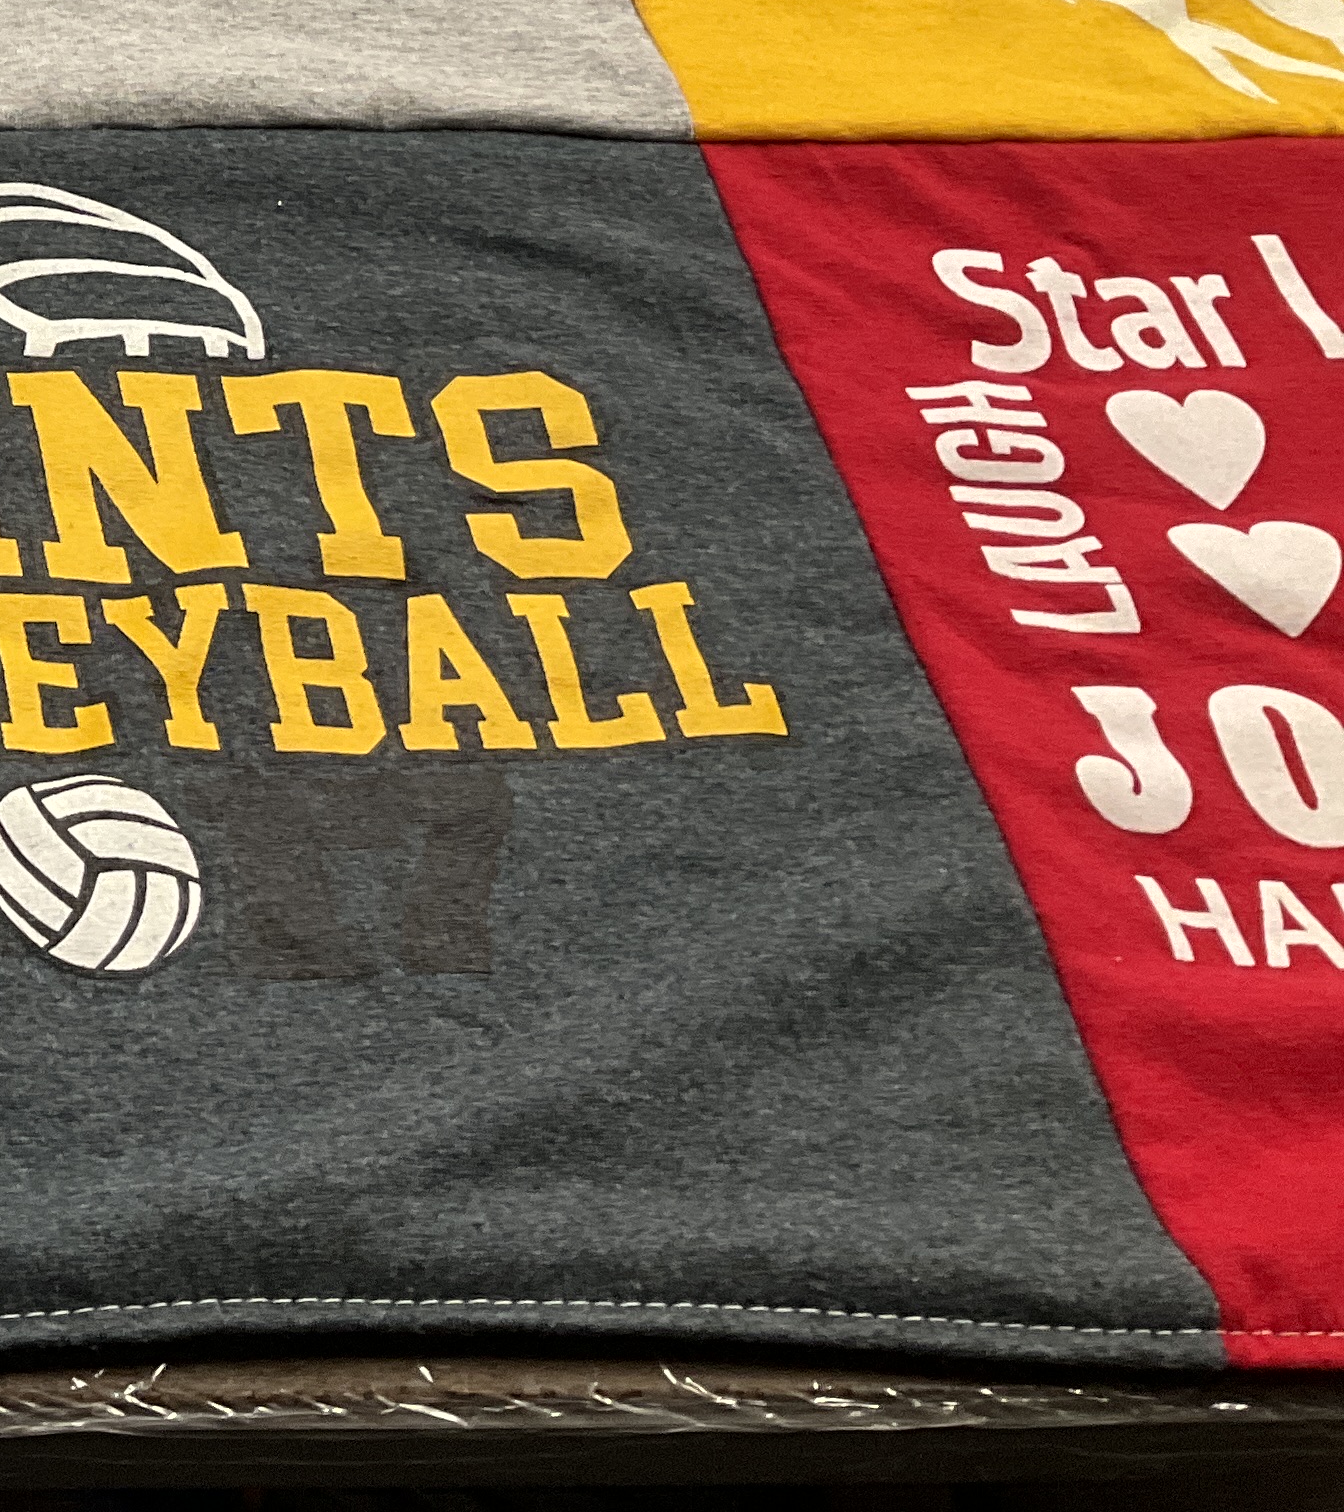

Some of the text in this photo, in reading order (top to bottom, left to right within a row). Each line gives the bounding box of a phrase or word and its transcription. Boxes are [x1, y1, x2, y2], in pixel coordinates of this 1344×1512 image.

[931, 248, 1247, 375] Star
[906, 378, 1142, 635] LAUGH
[1136, 875, 1344, 970] HA
